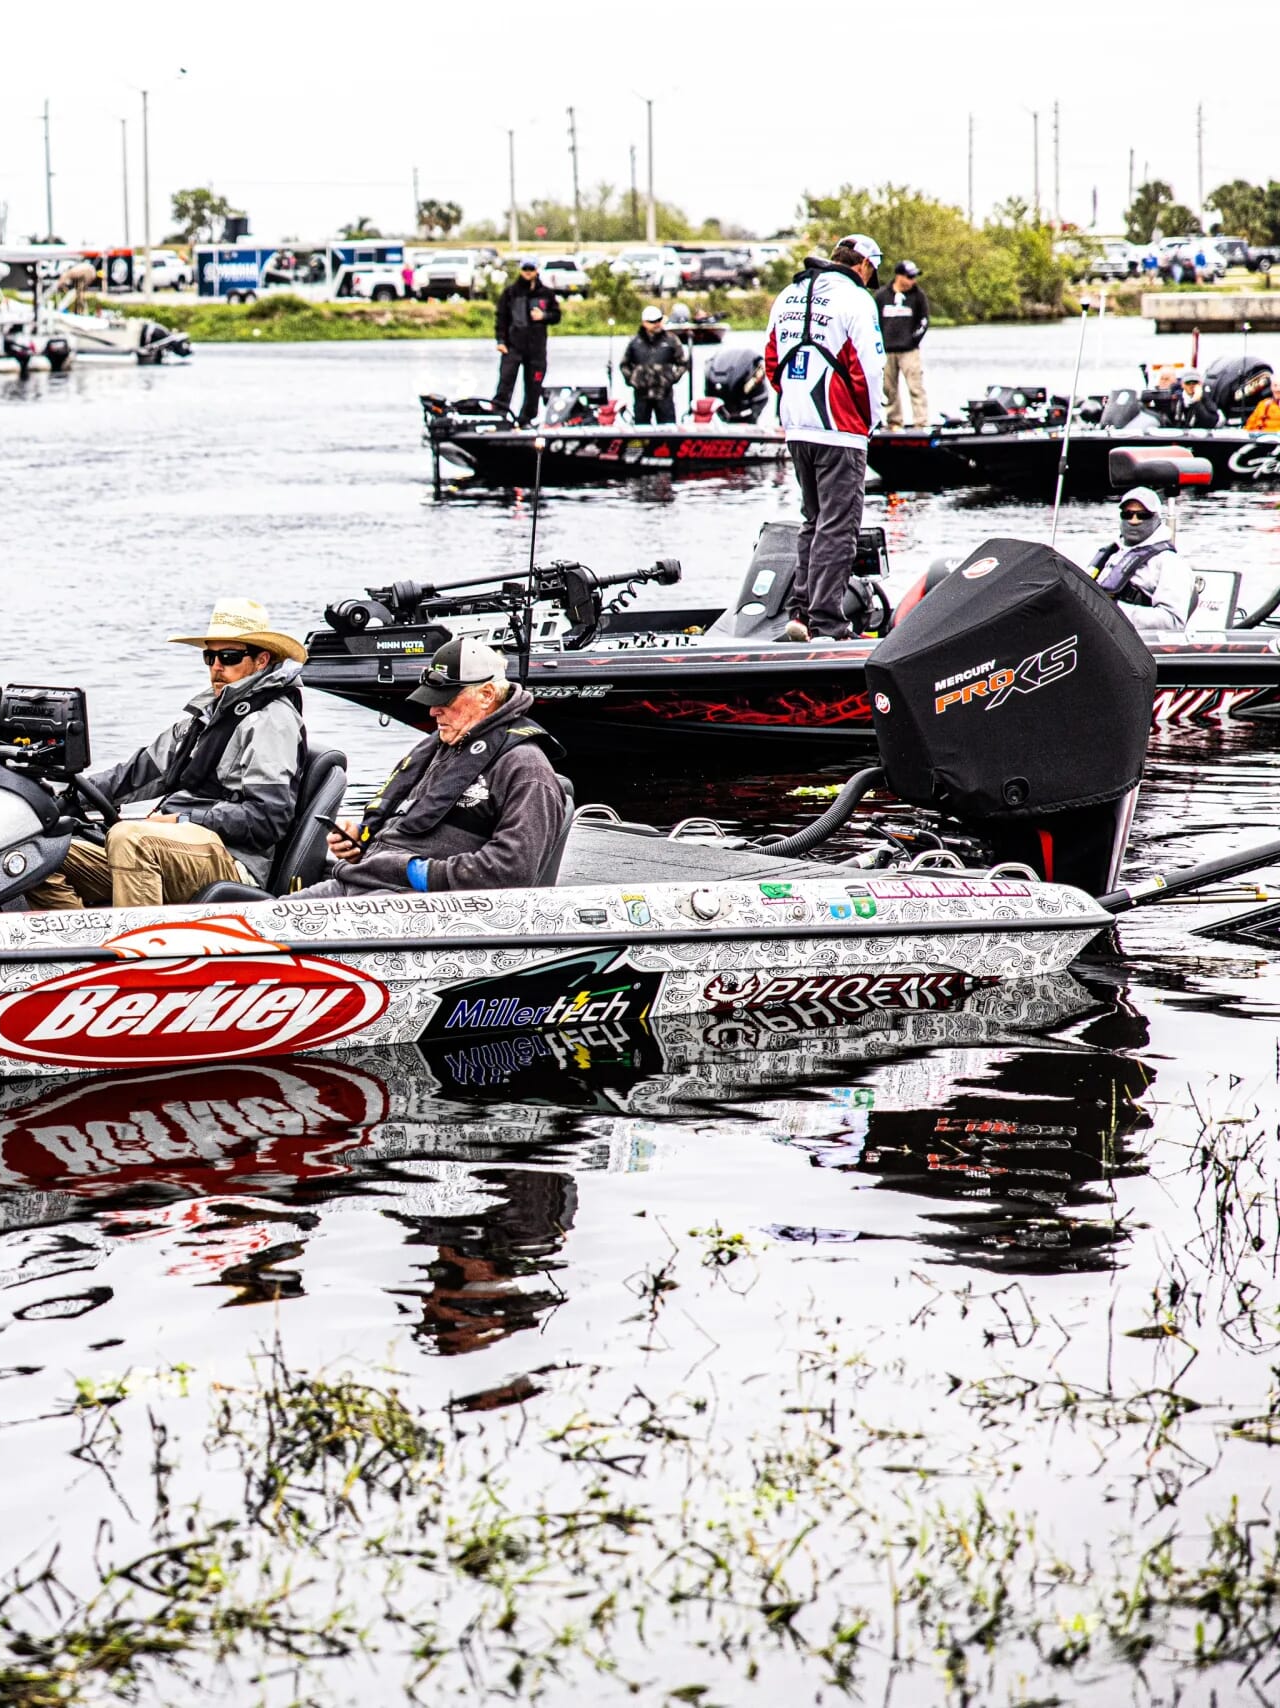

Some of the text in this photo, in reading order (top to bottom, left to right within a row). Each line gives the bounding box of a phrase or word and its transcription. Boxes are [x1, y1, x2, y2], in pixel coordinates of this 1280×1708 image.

[785, 296, 831, 307] CLOSE
[676, 439, 748, 458] SCHEELS
[377, 640, 424, 649] MINN KOTA
[935, 659, 996, 692] MERCURY
[26, 912, 109, 933] Garcia
[22, 979, 355, 1048] Berkley
[444, 991, 630, 1028] Millertech
